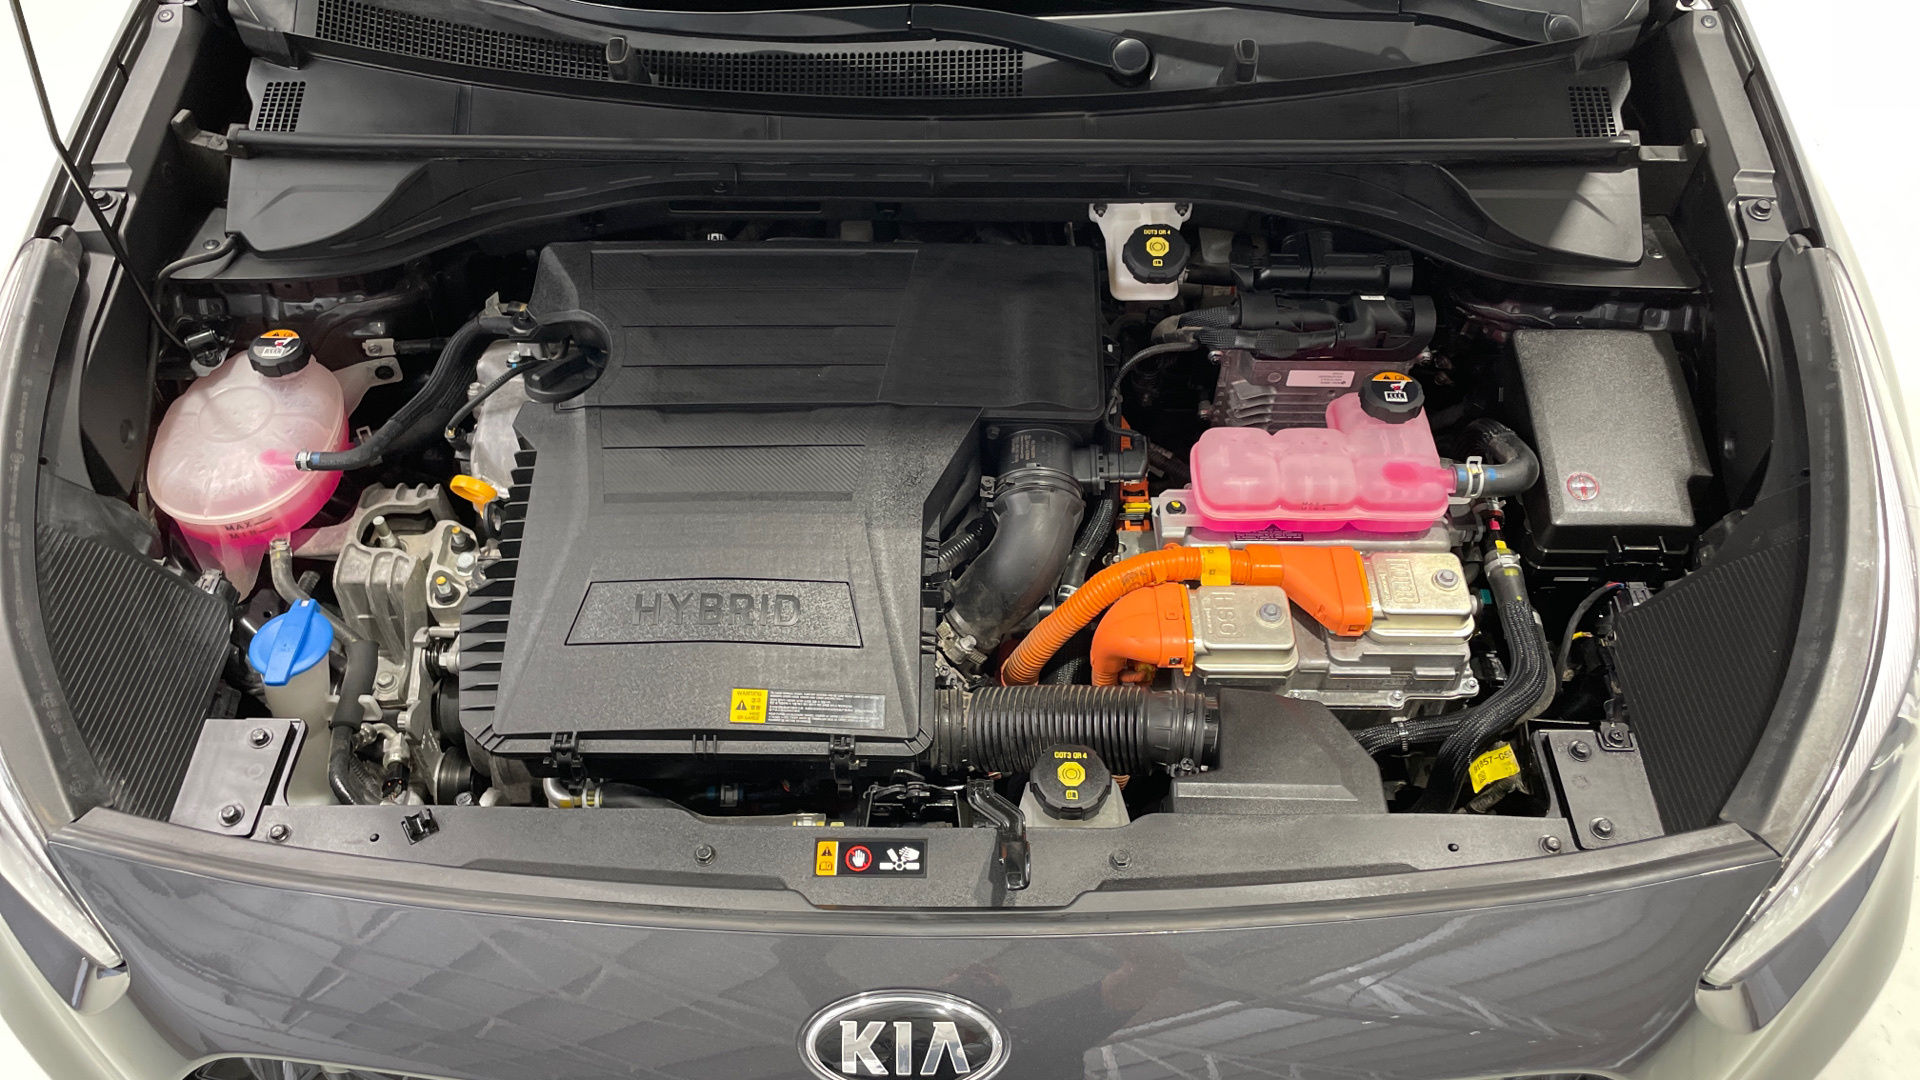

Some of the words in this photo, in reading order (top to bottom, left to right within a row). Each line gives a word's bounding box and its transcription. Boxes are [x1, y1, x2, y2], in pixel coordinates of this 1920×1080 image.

[224, 521, 252, 531] MAX
[229, 530, 257, 539] MIN
[632, 593, 801, 626] HYBRID
[1072, 751, 1082, 759] OR
[1082, 751, 1088, 759] 4
[839, 1020, 971, 1075] KIA
